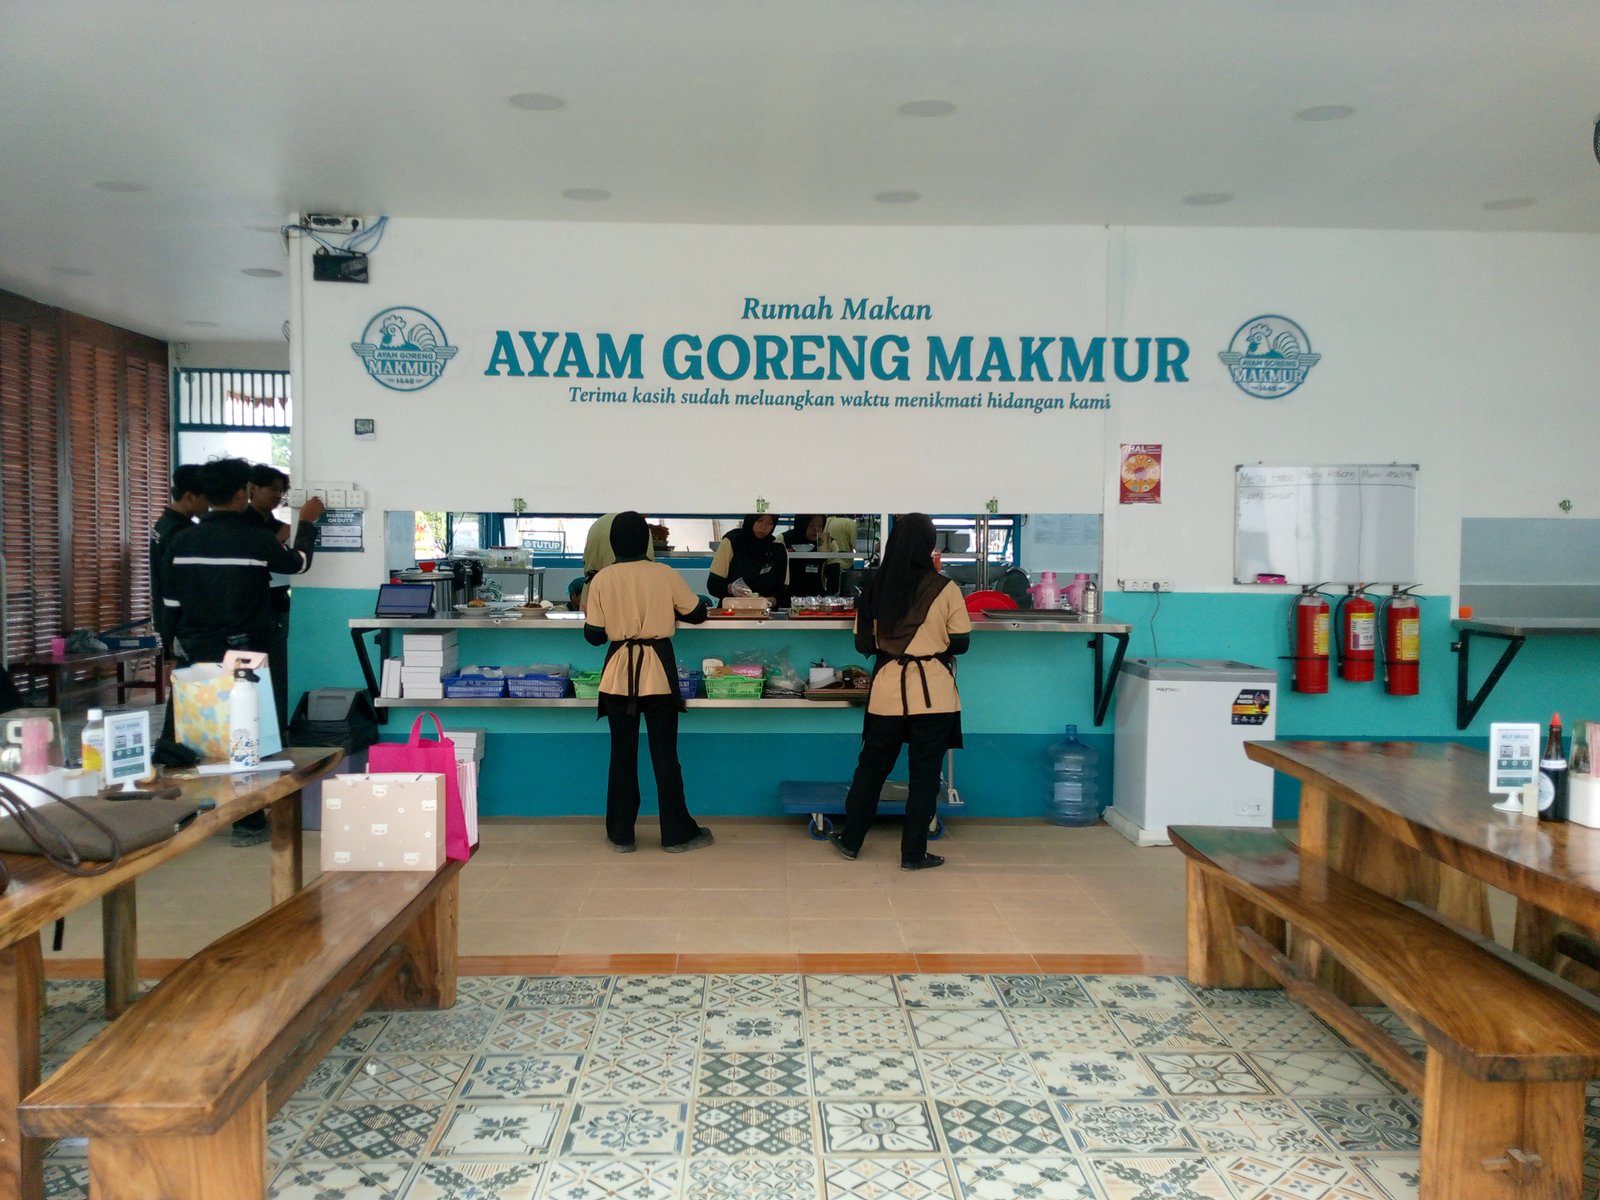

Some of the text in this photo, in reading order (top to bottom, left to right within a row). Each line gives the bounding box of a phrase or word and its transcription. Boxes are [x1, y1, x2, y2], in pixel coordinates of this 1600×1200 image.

[741, 296, 932, 321] Rumah Makan
[376, 351, 434, 360] AYAM GORENG
[484, 330, 1190, 383] AYAM GORENG MAKMUR
[368, 360, 443, 377] MAKMUR
[1234, 368, 1304, 384] MAKMUR
[569, 387, 1111, 414] Terima kasih sudah meluangkan waktu menikmati hidangan kami
[532, 541, 560, 549] TUTUP
